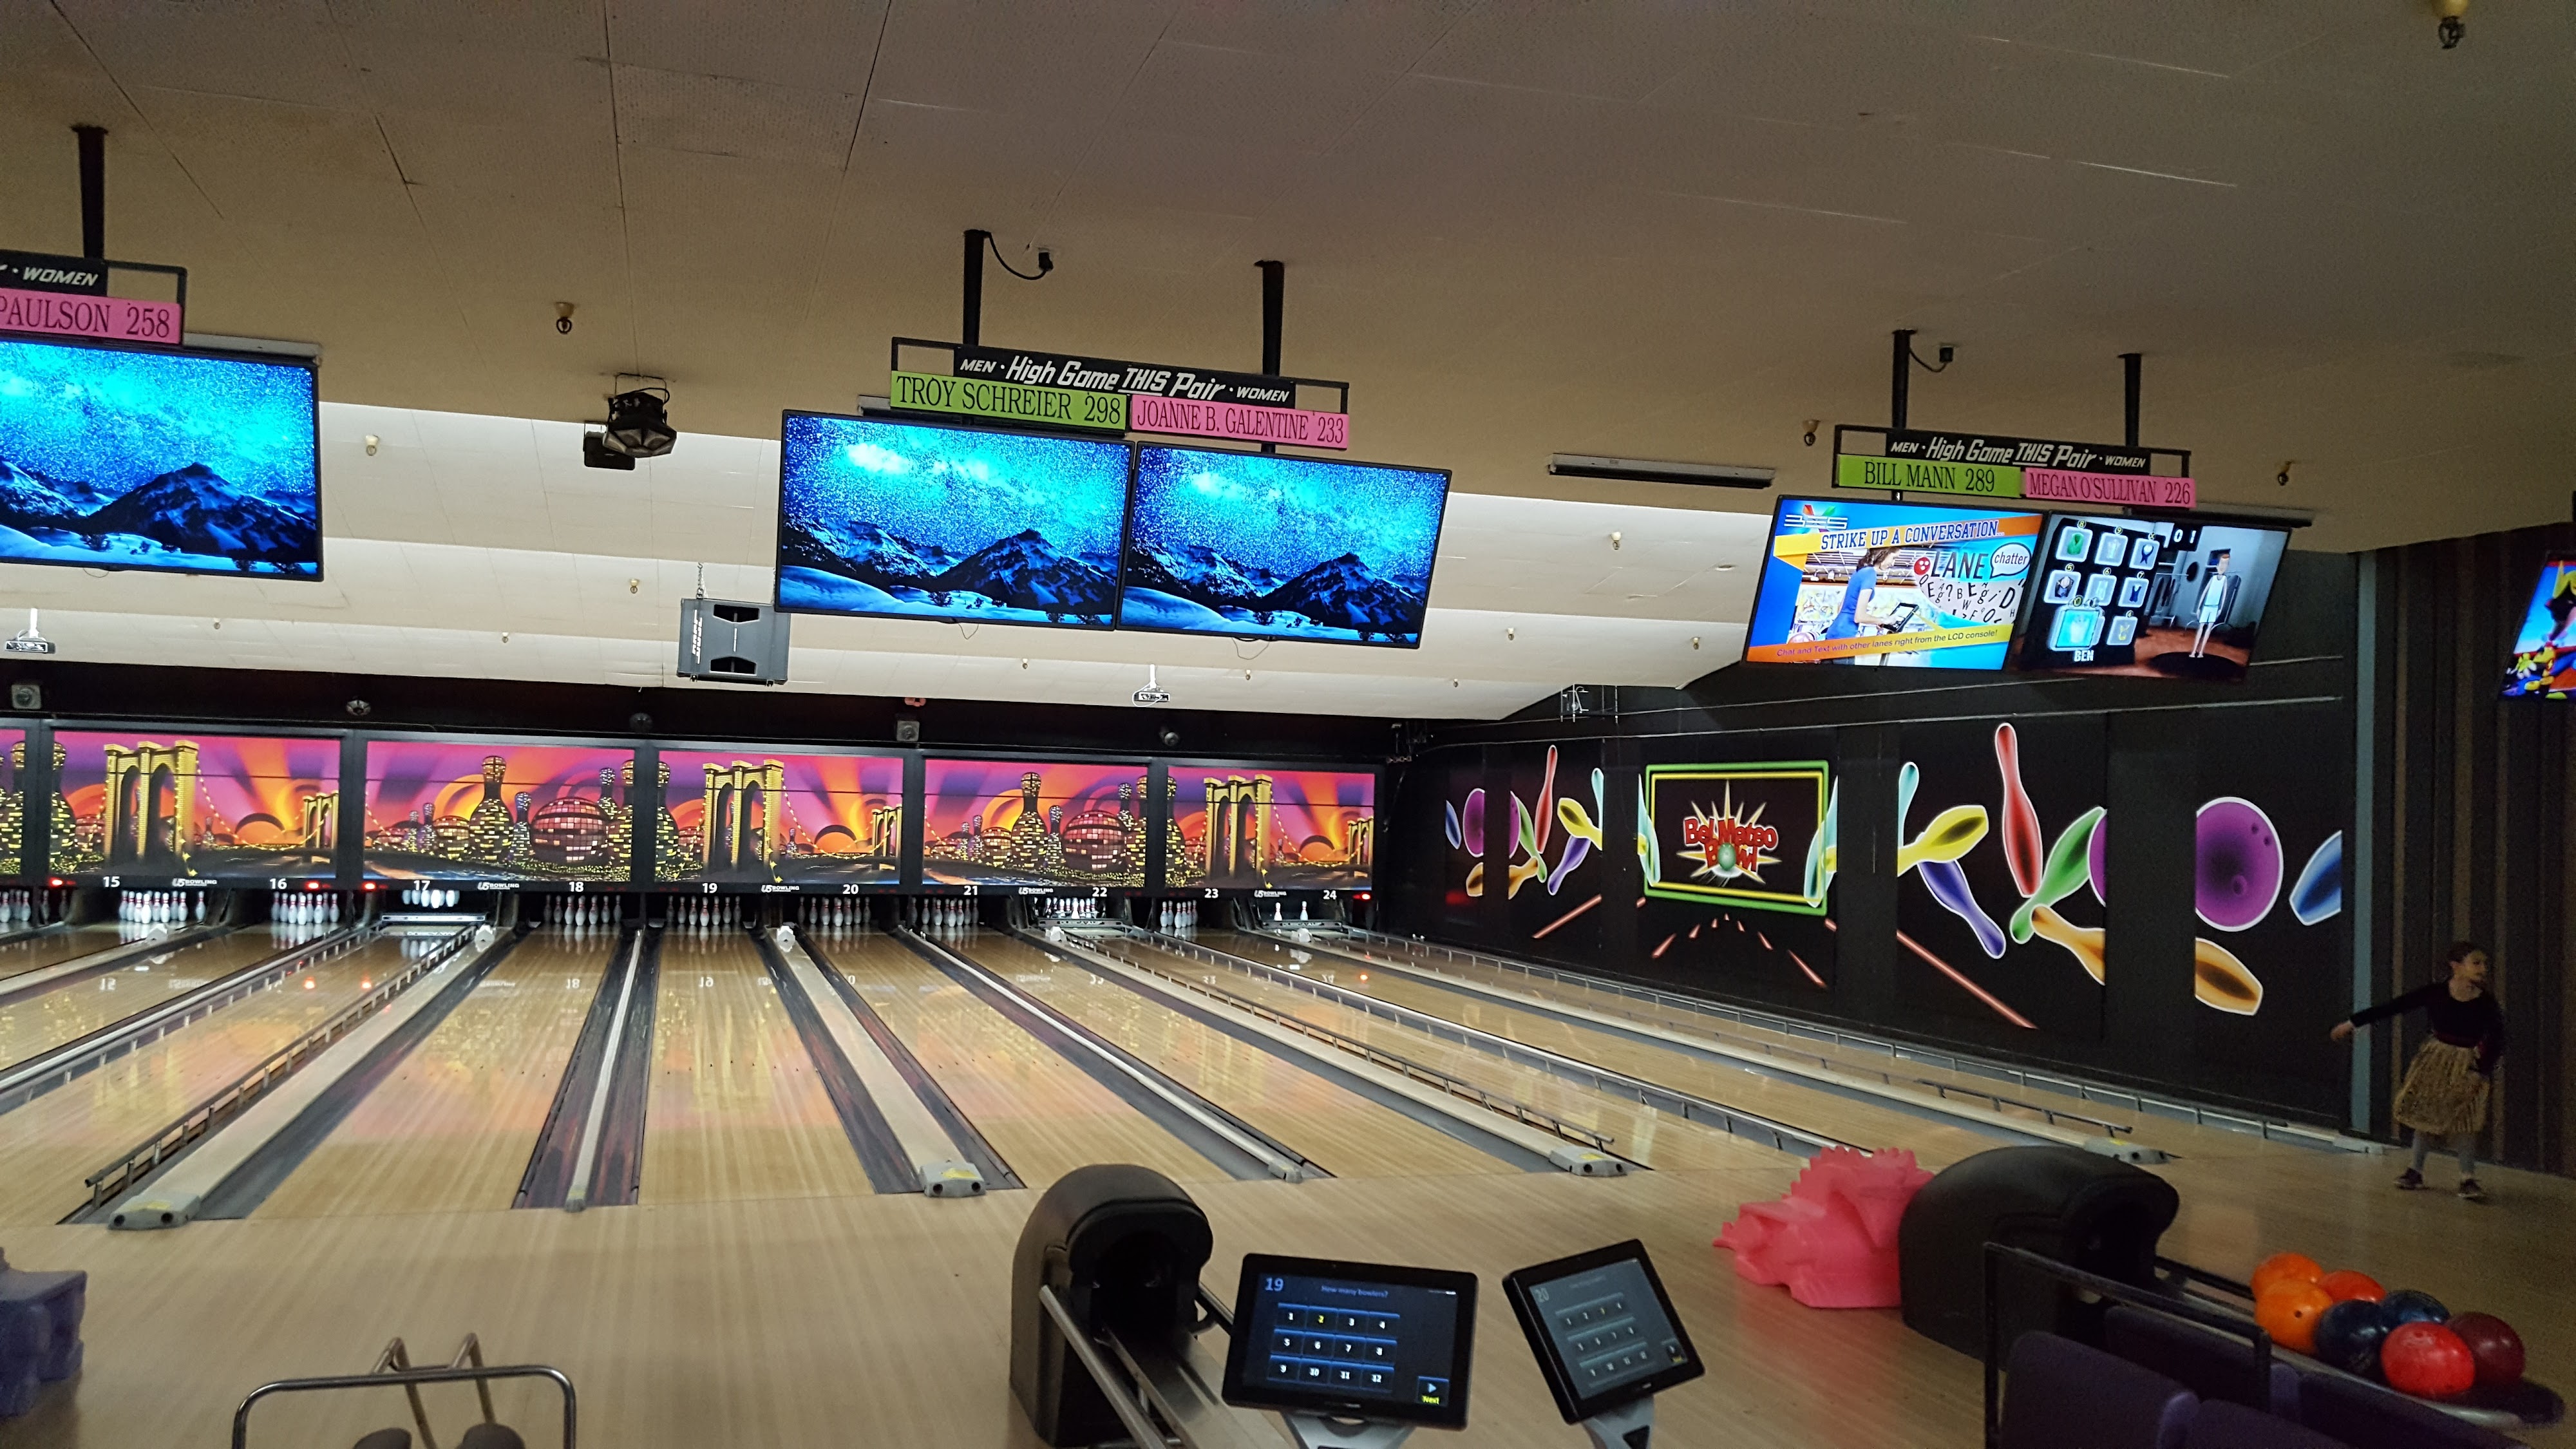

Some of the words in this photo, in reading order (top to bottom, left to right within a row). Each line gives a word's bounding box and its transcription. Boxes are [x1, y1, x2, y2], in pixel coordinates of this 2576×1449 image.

[23, 267, 98, 287] WOMEN
[126, 306, 169, 338] 258
[960, 359, 997, 374] MEN
[1005, 355, 1056, 385] High
[1057, 361, 1120, 391] Game
[1122, 368, 1173, 392] THIS
[1169, 372, 1226, 401] Pair
[1236, 386, 1289, 402] WOMEN
[896, 376, 956, 407] TROY
[962, 383, 1072, 419] SCHREIER
[1084, 395, 1121, 424] 298
[1138, 401, 1201, 430] JOANNE
[1206, 406, 1219, 431] B.
[1226, 408, 1309, 440] GALENTINE
[1318, 417, 1343, 443] 233
[1891, 442, 1919, 453] MEN
[1926, 437, 1965, 461] High
[1965, 439, 2014, 463] Game
[2015, 442, 2054, 462] THIS
[2052, 445, 2097, 468] Pair
[2105, 455, 2146, 468] WOMEN
[1864, 462, 1902, 485] BILL
[1906, 464, 1956, 489] MANN
[1965, 469, 1994, 491] 289
[2030, 473, 2078, 497] MEGAN
[2081, 477, 2157, 502] O'SULLIVAN
[2165, 482, 2190, 504] 226
[1821, 531, 1866, 550] STRIKE
[1871, 530, 1888, 545] UP
[1891, 529, 1900, 544] A
[1931, 551, 1989, 579] LANE
[1994, 552, 2028, 565] chatter
[1895, 638, 1913, 647] right
[1965, 630, 1998, 639] console!
[2074, 650, 2094, 661] BEN
[1684, 818, 1714, 844] Bel
[103, 876, 120, 887] 15
[270, 878, 287, 889] 16
[413, 880, 431, 891] 17
[569, 881, 584, 892] 18
[702, 882, 717, 893] 19
[842, 884, 859, 895] 20
[963, 886, 978, 896] 21
[1092, 887, 1108, 897] 22
[1204, 888, 1219, 898] 23
[1323, 890, 1337, 900] 24
[1264, 1277, 1284, 1291] 19
[1318, 1315, 1324, 1323] 2
[1349, 1318, 1354, 1326] 3
[1379, 1321, 1385, 1329] 4
[1283, 1338, 1290, 1347] 5
[1314, 1341, 1321, 1349] 6
[1345, 1344, 1351, 1352] 7
[1376, 1347, 1383, 1356] 8
[1280, 1364, 1286, 1373] 9
[1310, 1367, 1320, 1377] 10
[1341, 1370, 1350, 1379] 11
[1372, 1374, 1381, 1383] 12
[1422, 1396, 1439, 1405] Next
